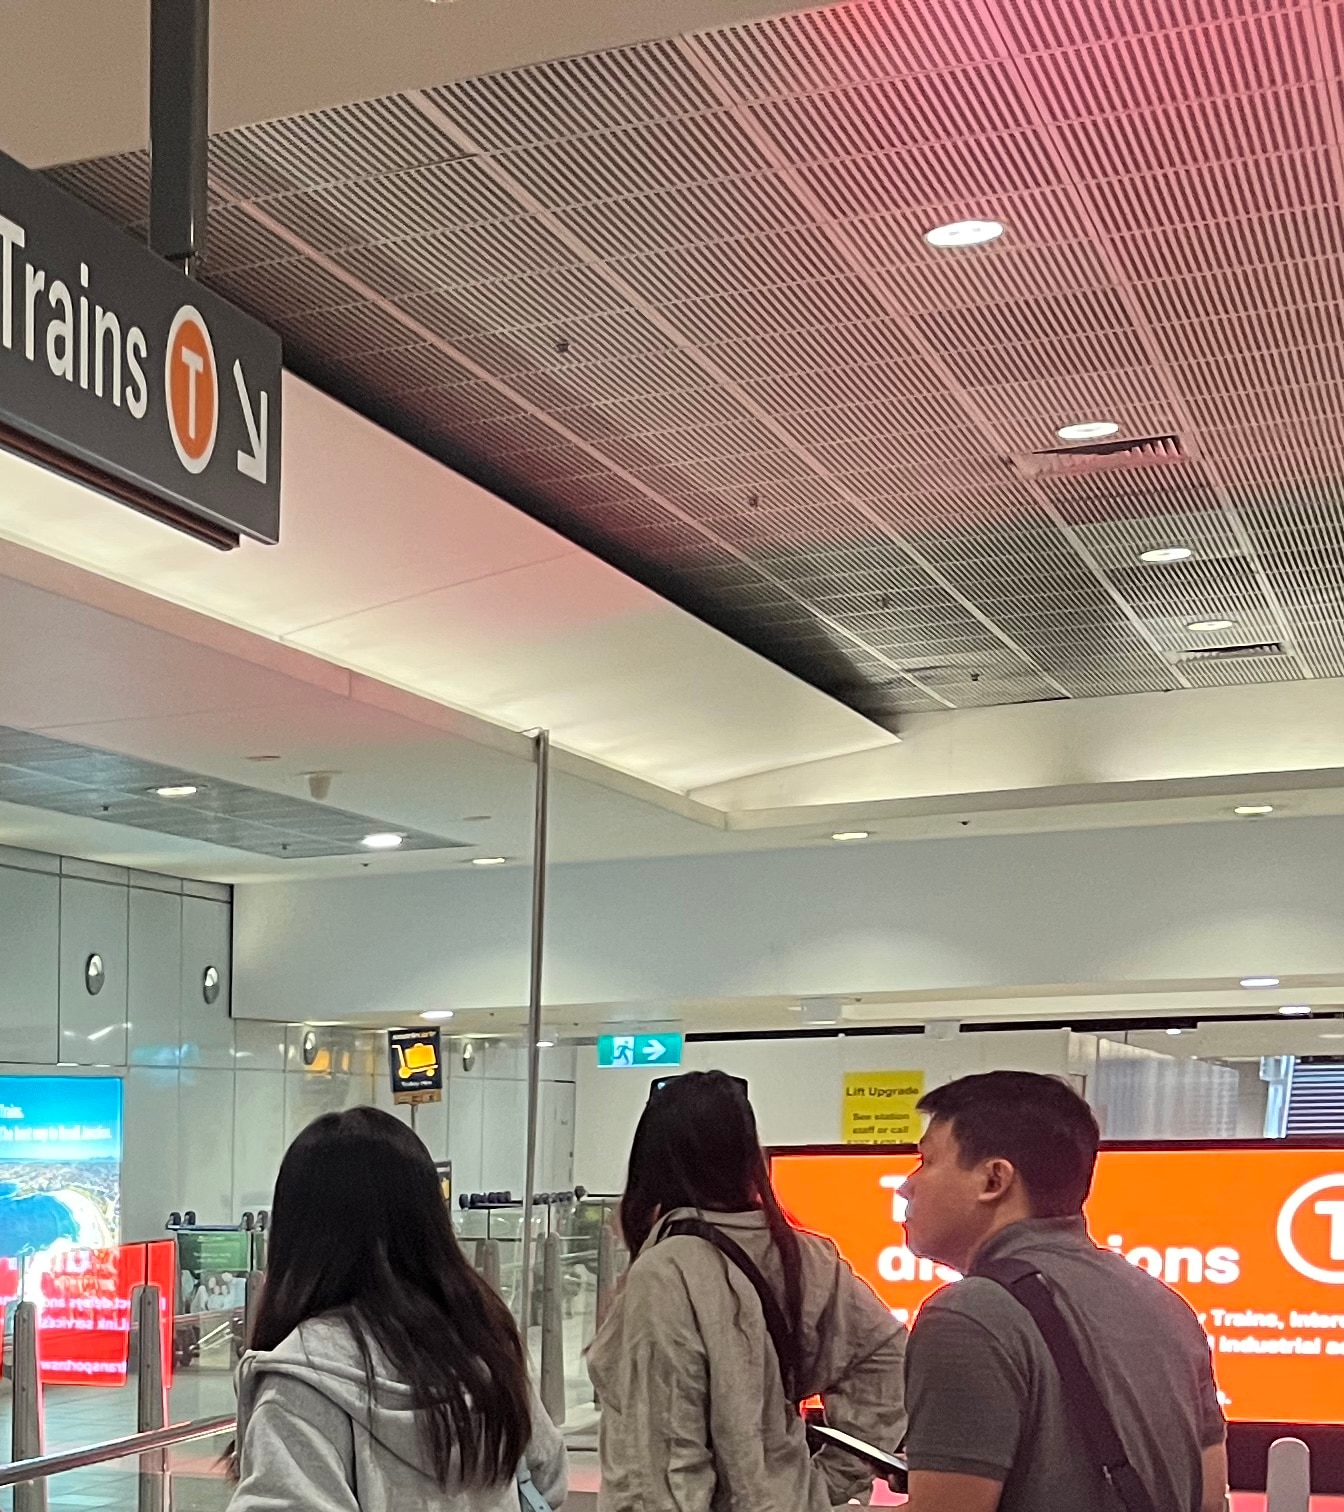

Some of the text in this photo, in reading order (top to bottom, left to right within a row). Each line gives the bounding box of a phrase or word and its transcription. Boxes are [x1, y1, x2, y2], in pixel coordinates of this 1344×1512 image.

[846, 1087, 918, 1098] Lift Upgrade
[1211, 1310, 1284, 1330] Trains,
